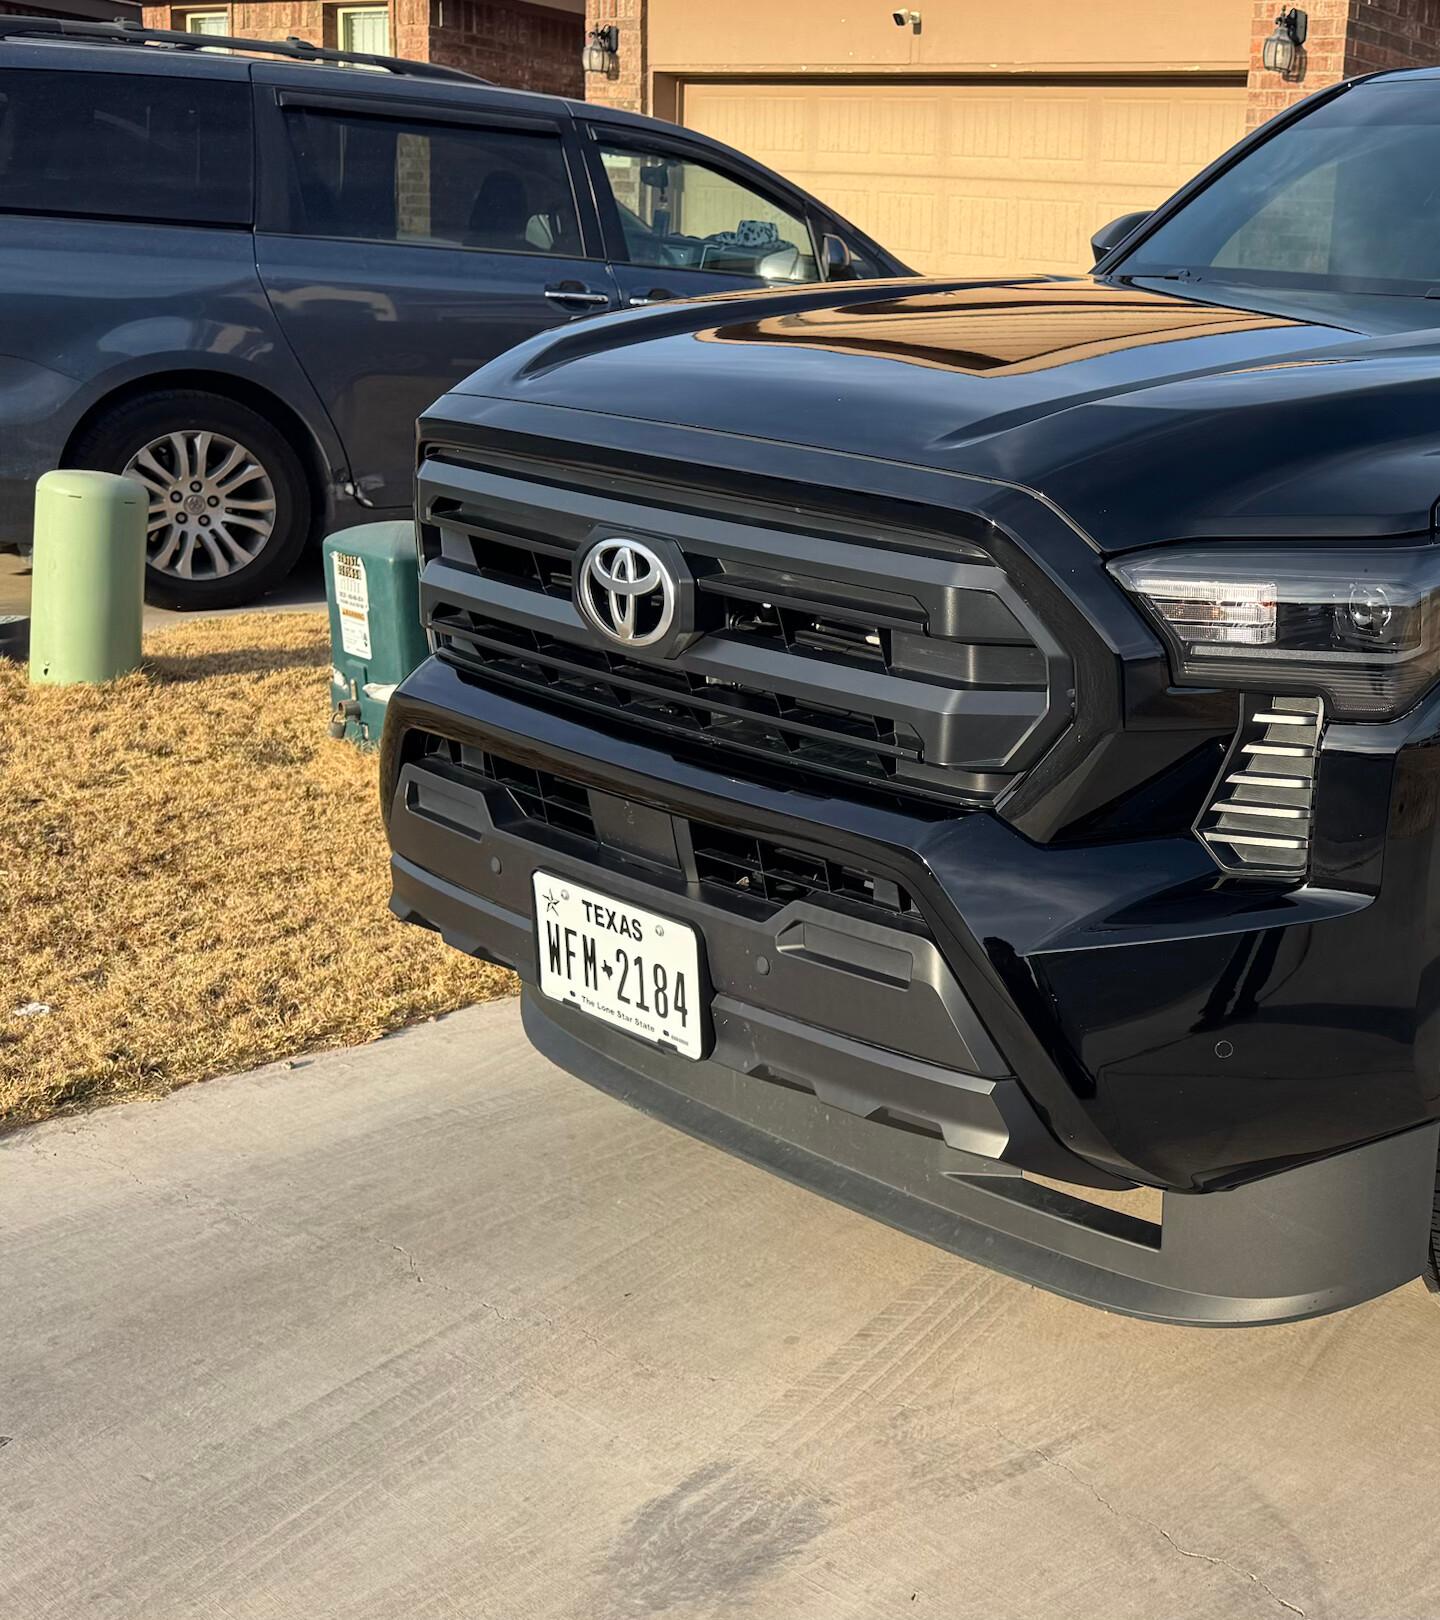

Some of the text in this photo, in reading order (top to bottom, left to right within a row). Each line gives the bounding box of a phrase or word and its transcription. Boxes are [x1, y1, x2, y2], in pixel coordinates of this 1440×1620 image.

[582, 899, 643, 942] TEXAS
[546, 920, 688, 1028] WFM 2184
[581, 995, 655, 1032] The Lone Star State
